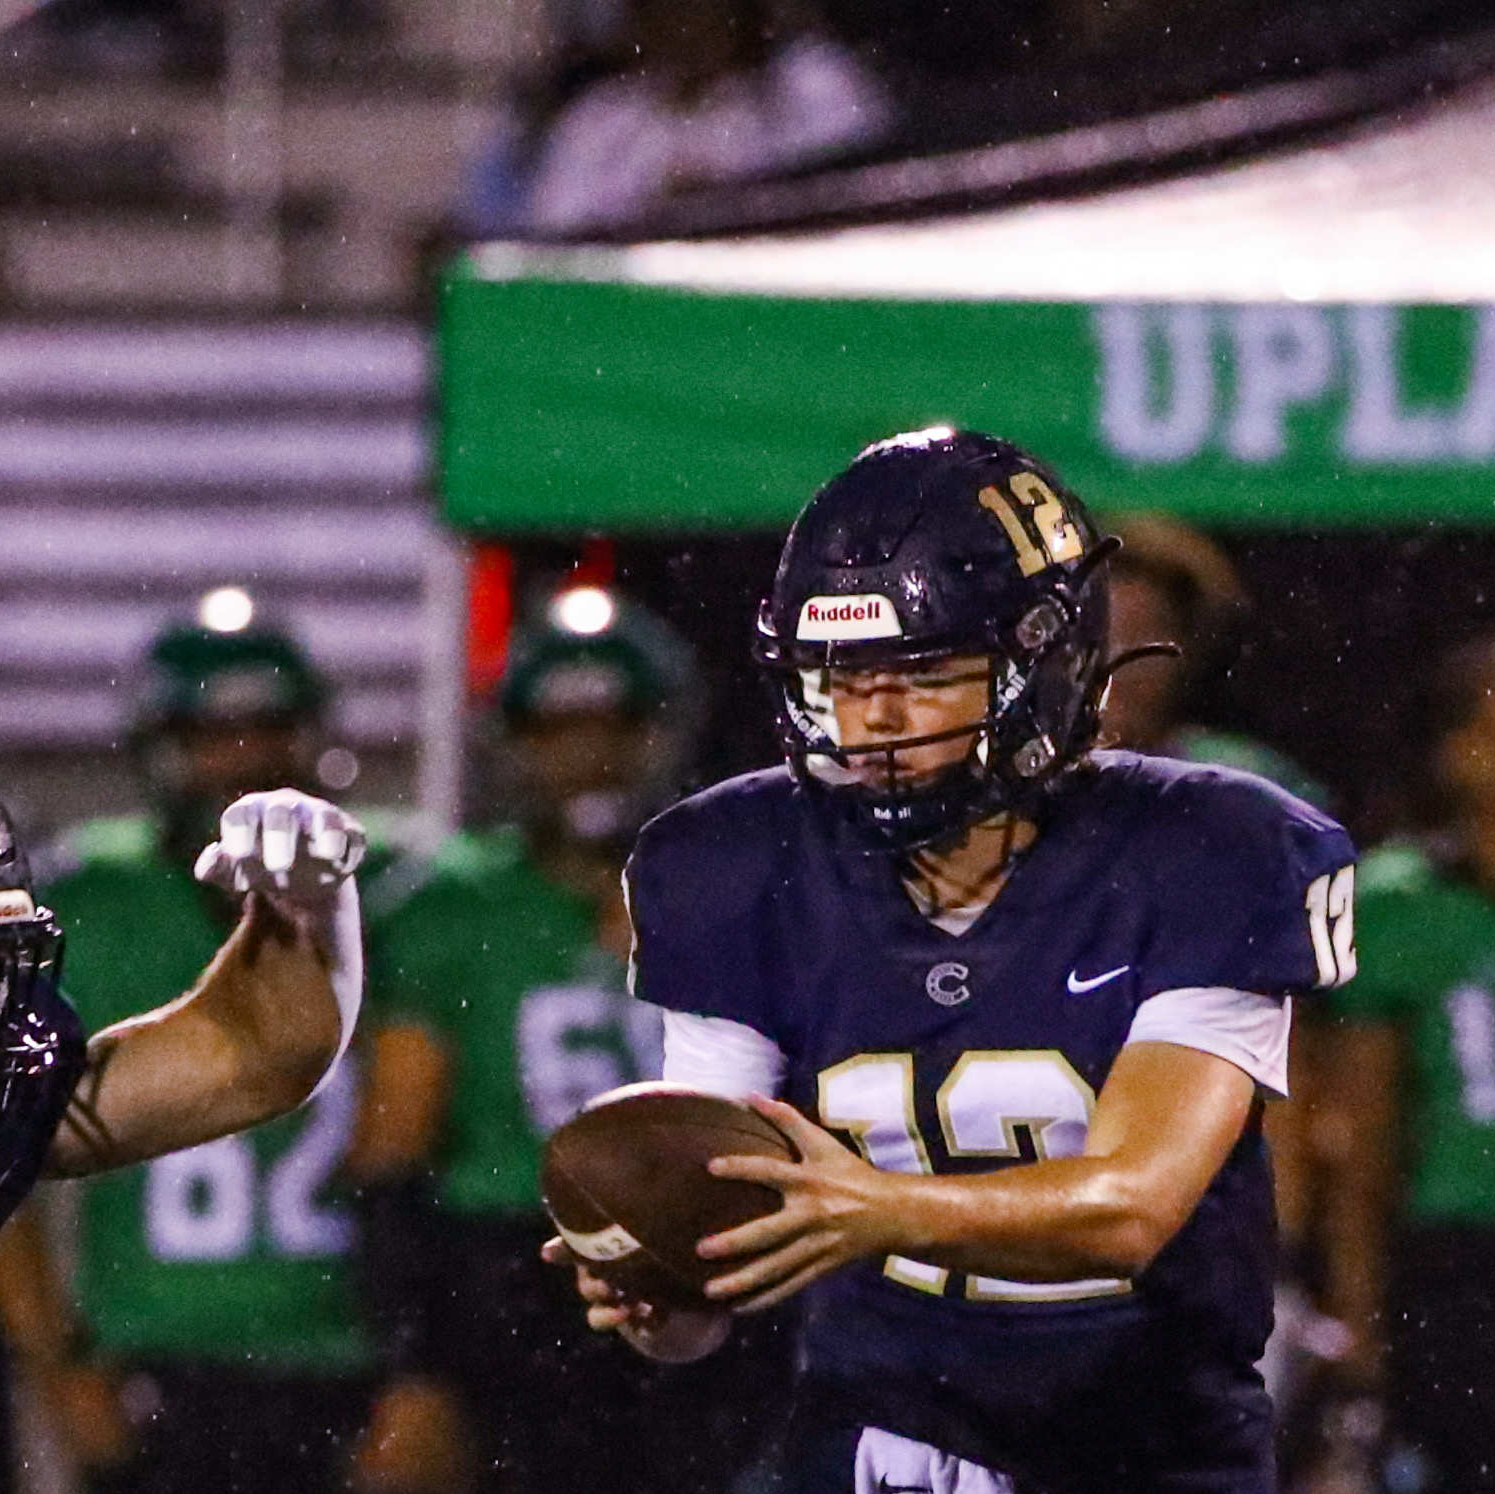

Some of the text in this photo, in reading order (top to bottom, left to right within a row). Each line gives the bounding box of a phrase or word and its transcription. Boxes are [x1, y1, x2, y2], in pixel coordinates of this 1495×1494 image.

[979, 470, 1084, 578] 12
[806, 601, 882, 622] Riddell
[1306, 864, 1358, 989] 12
